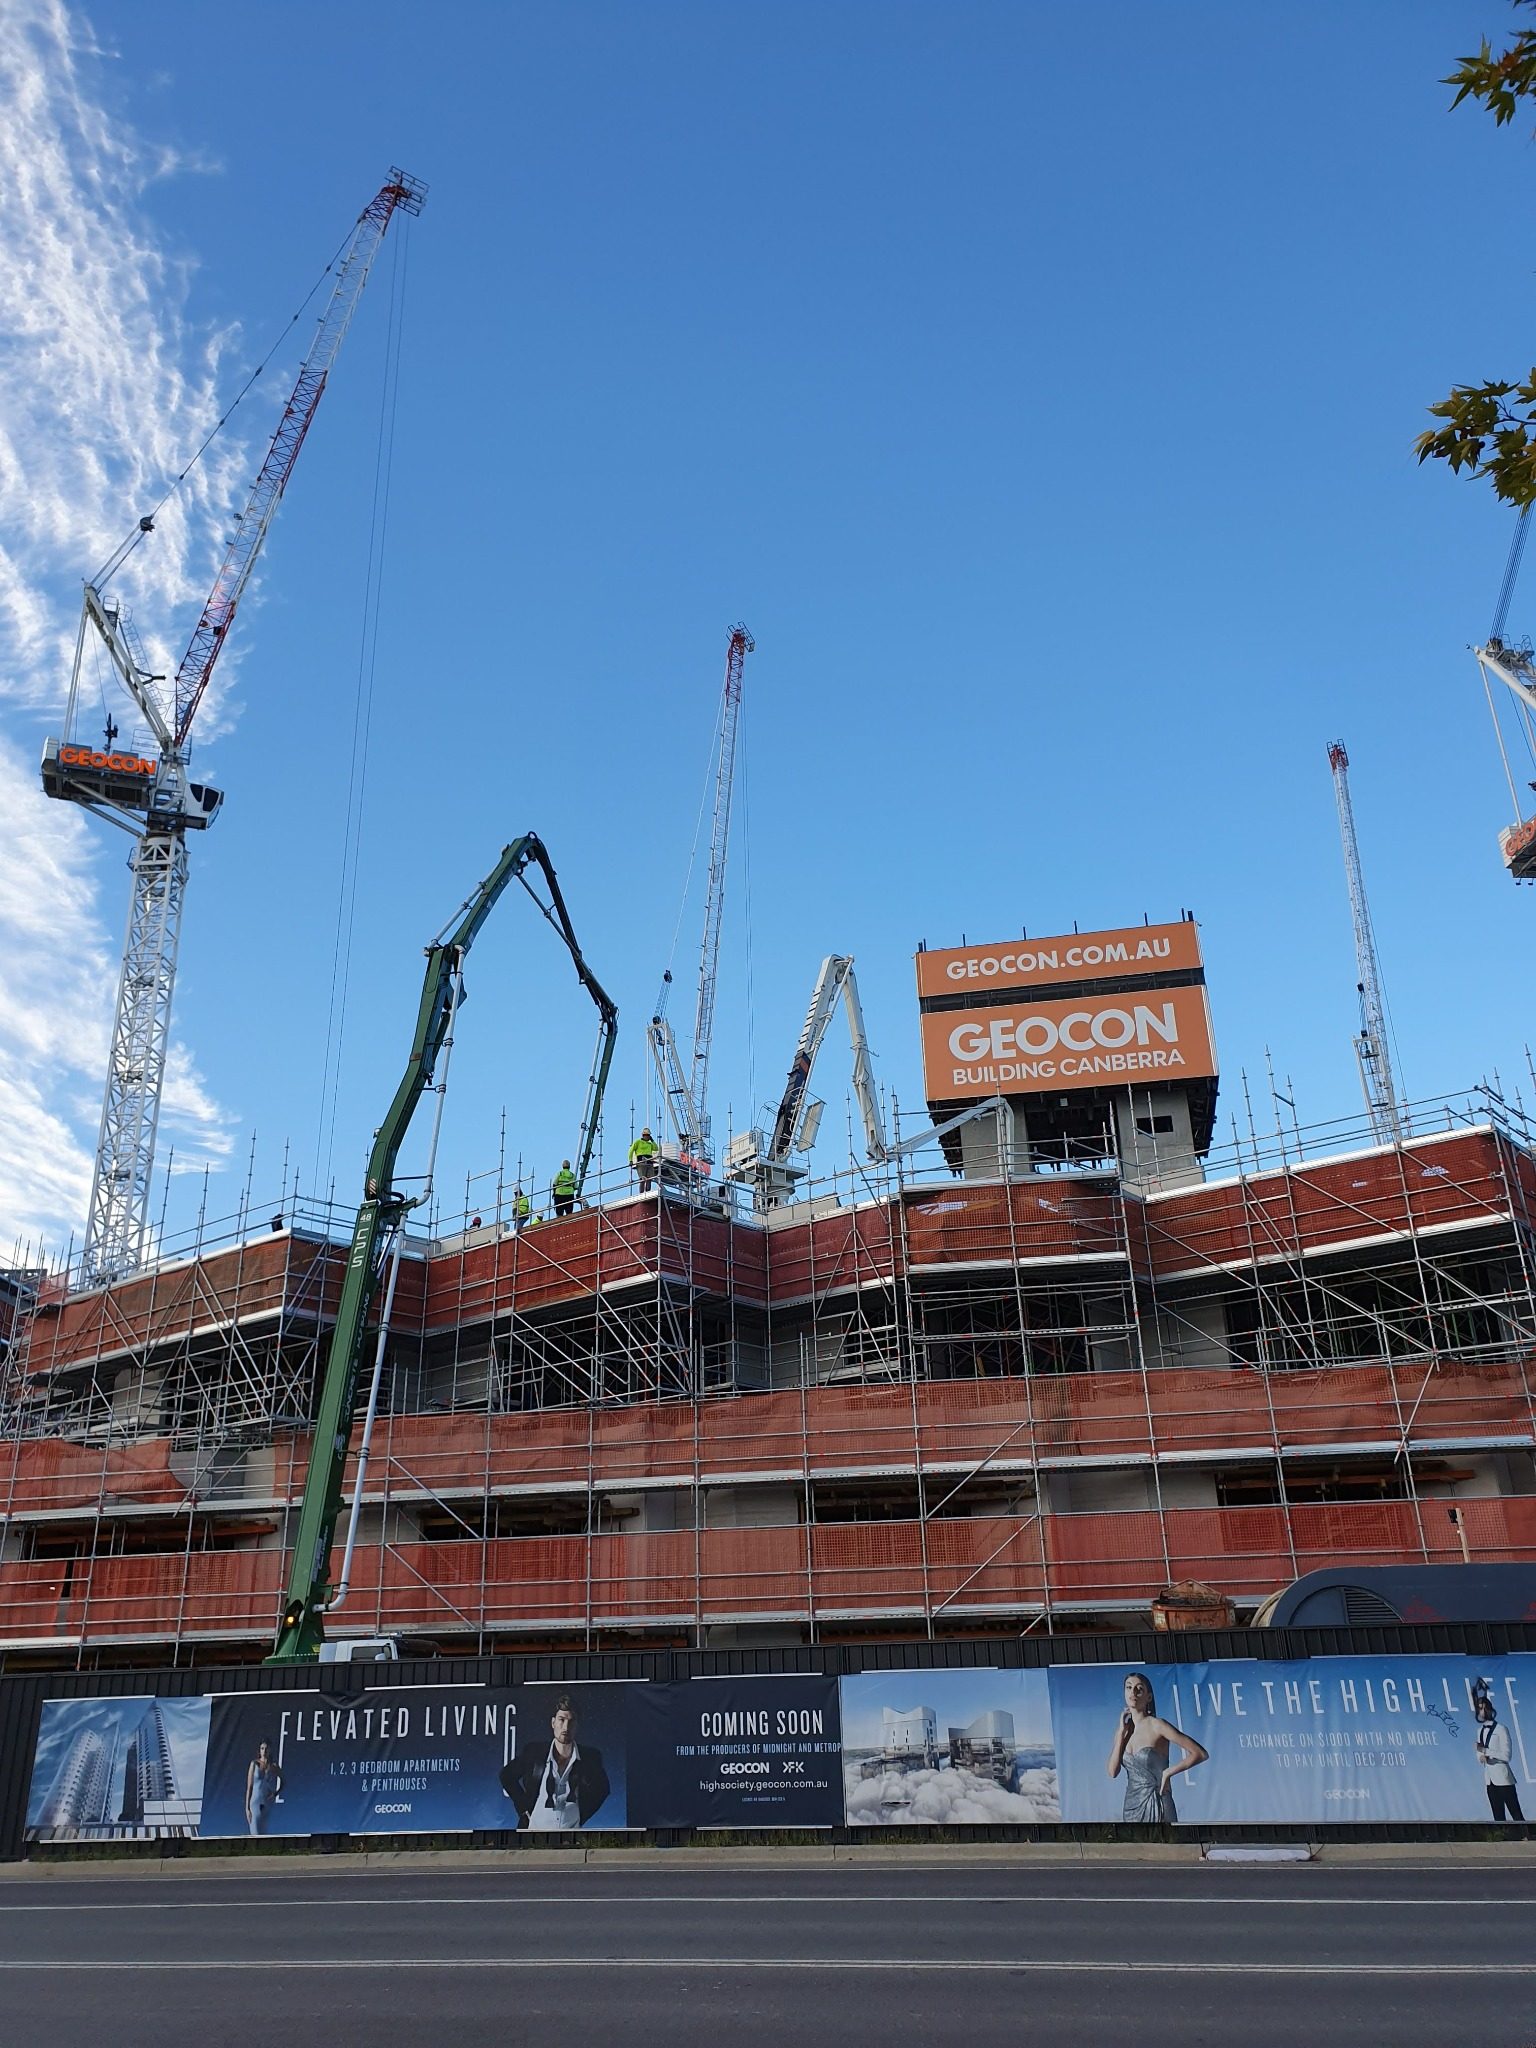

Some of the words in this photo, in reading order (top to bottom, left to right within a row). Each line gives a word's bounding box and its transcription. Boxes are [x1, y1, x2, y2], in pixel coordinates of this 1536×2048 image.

[60, 747, 157, 775] GEOCON
[946, 938, 1171, 980] GEOCON.COM.AU
[948, 1002, 1179, 1062] GEOCON
[953, 1060, 1057, 1086] BUILDING
[1059, 1048, 1186, 1076] CANBERRA
[360, 1213, 372, 1222] 48
[1261, 1680, 1325, 1715] THE
[1339, 1678, 1429, 1713] HIGH
[701, 1711, 769, 1738] COMING
[777, 1709, 824, 1735] SOON
[1239, 1733, 1295, 1748] EXCHANGE
[1300, 1733, 1313, 1747] ON
[1318, 1732, 1351, 1748] $1000
[1355, 1732, 1383, 1746] WITH
[1388, 1731, 1402, 1745] NO
[1407, 1731, 1438, 1746] MORE
[676, 1745, 695, 1756] FROM
[697, 1744, 709, 1755] THE
[711, 1743, 750, 1755] PRODUCERS
[752, 1743, 761, 1754] OF
[763, 1742, 796, 1754] MIDNIGHT
[799, 1742, 812, 1753] AND
[351, 1761, 356, 1775] 3
[360, 1759, 400, 1774] BEDROOM
[404, 1758, 461, 1773] APARTMENTS
[1276, 1754, 1290, 1768] TO
[1295, 1753, 1315, 1768] PAY
[1319, 1752, 1351, 1768] UNTIL
[1355, 1752, 1376, 1767] DEC
[1381, 1752, 1406, 1767] 2018
[720, 1762, 770, 1775] GEOCON
[361, 1779, 368, 1792] &
[371, 1777, 427, 1792] PENTHOUSES
[699, 1779, 828, 1793] highsociety.geocon.com.au
[1324, 1788, 1370, 1800] GEOCON
[374, 1803, 412, 1814] GEOCON
